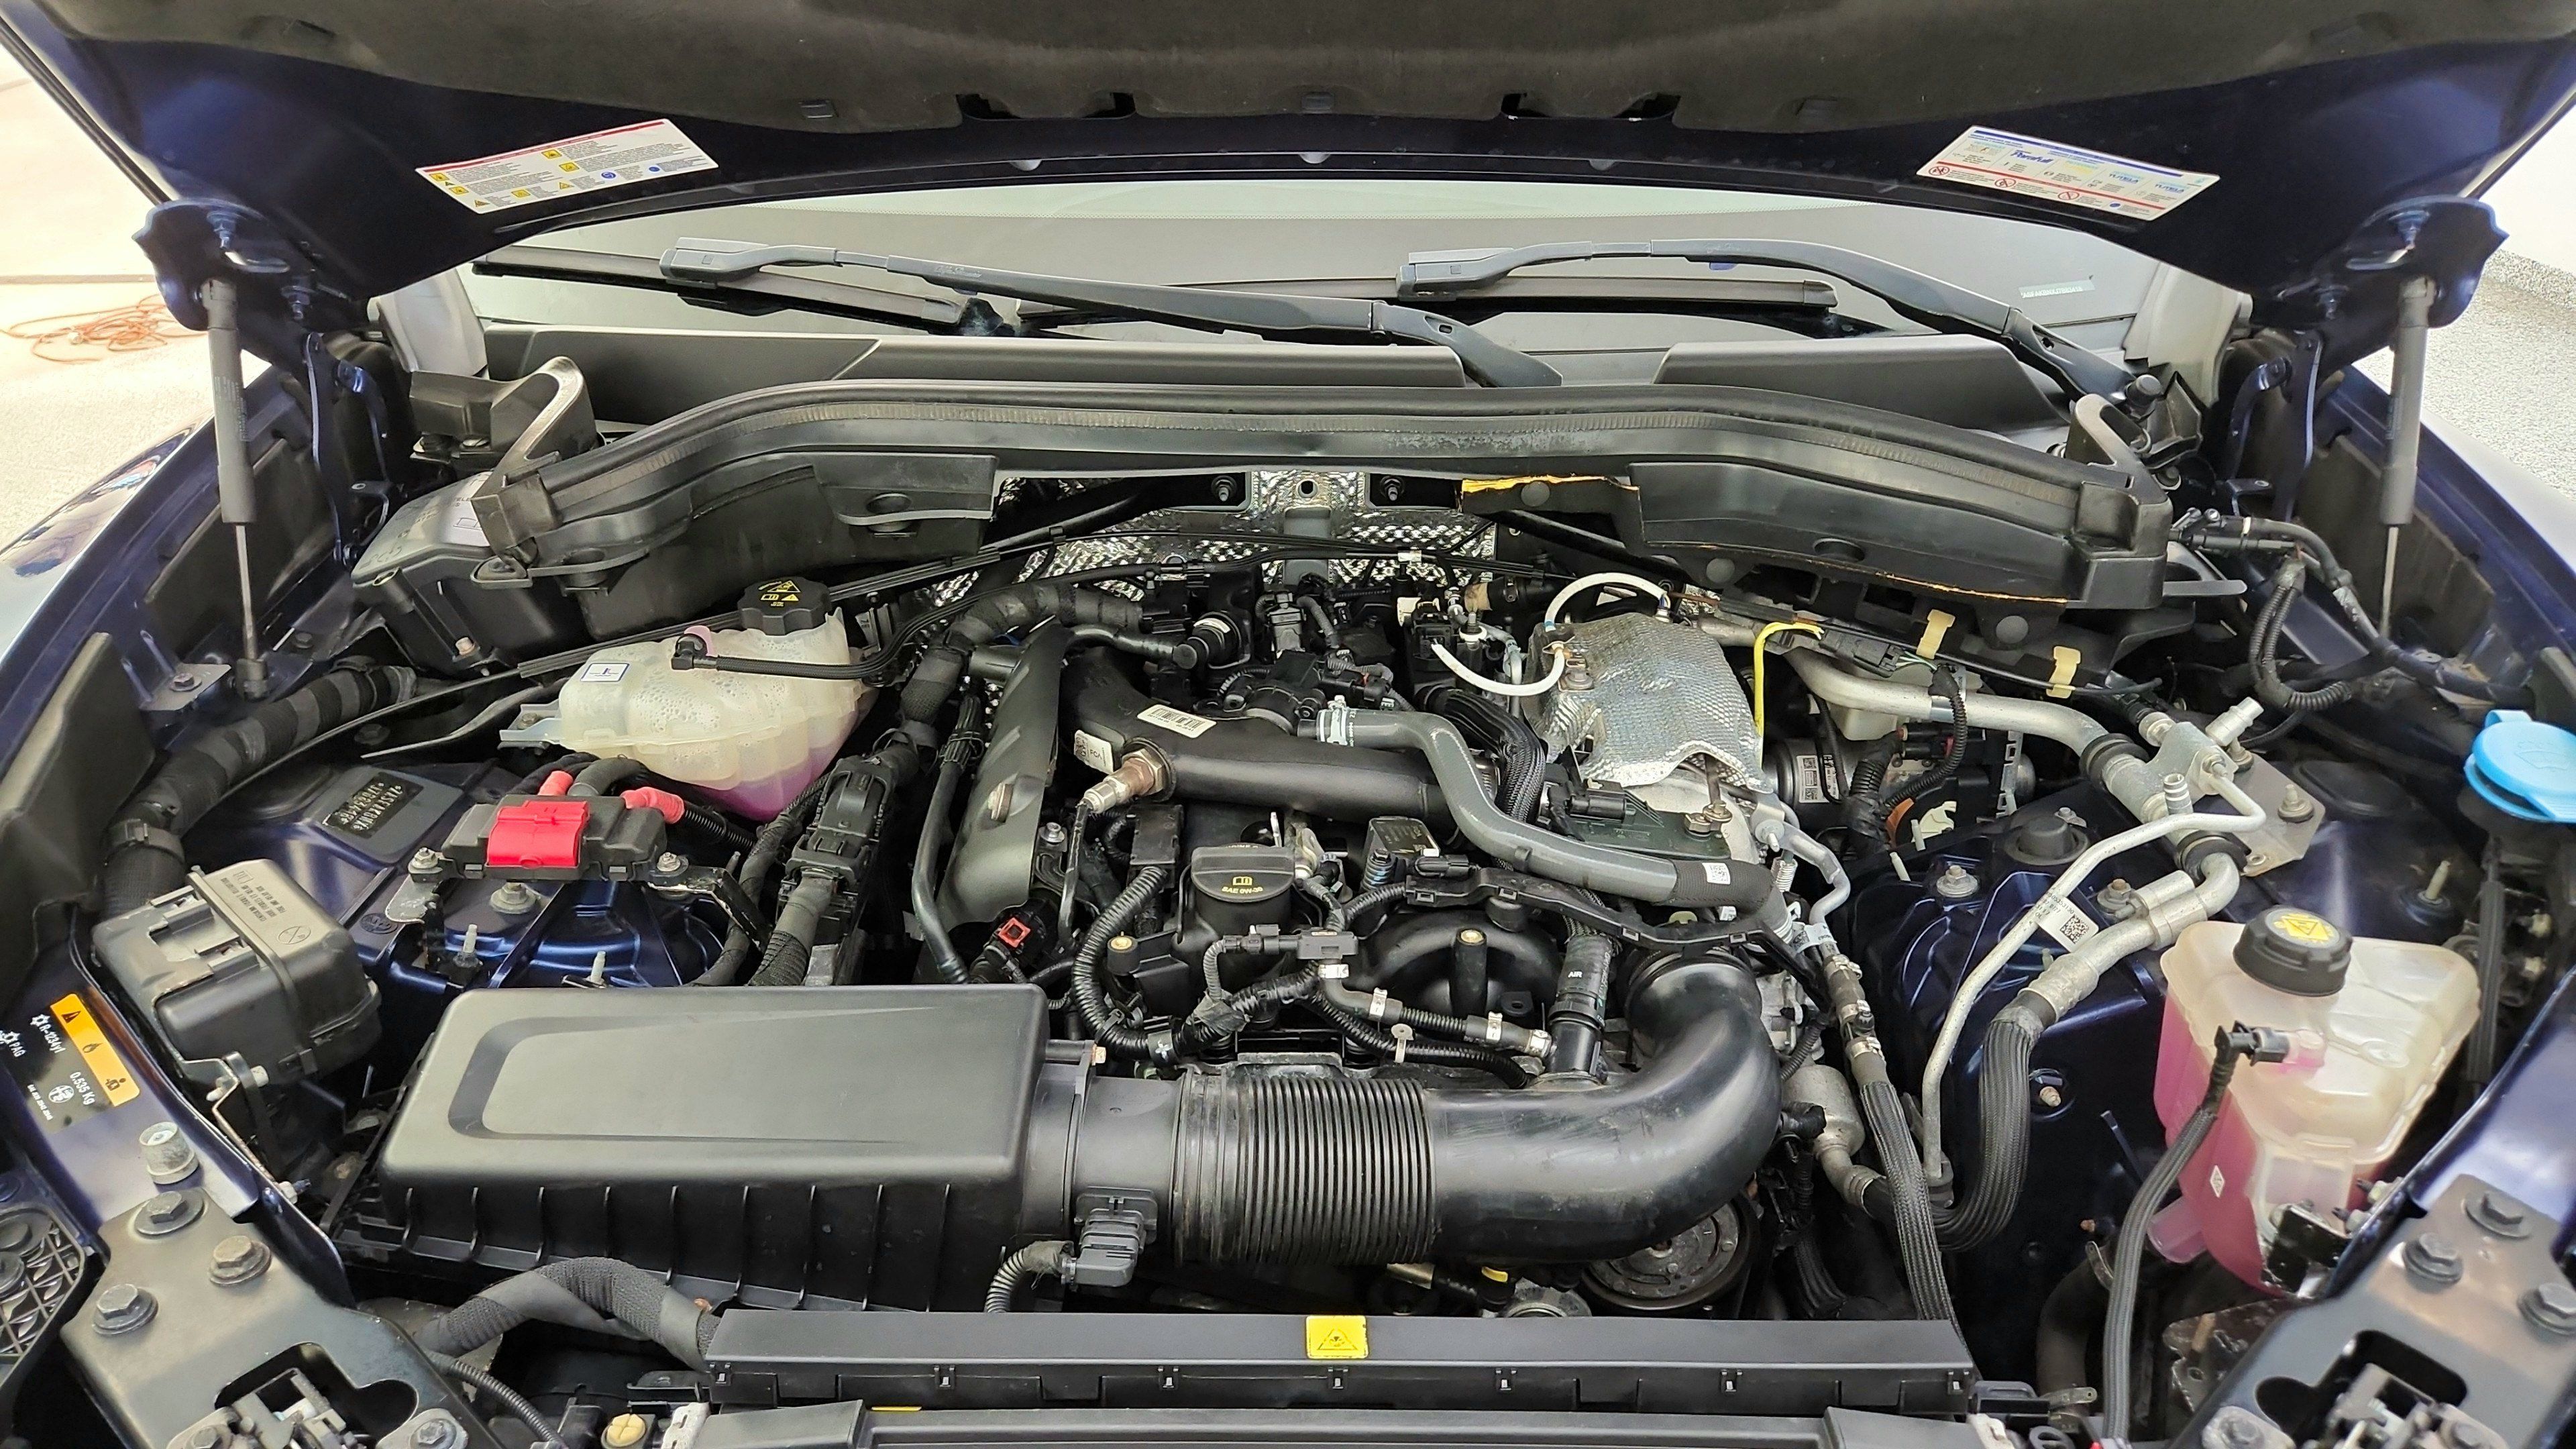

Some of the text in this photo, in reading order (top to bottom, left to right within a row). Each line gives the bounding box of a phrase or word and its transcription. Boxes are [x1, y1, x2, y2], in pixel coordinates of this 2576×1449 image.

[9, 1041, 26, 1058] PAG
[69, 1071, 96, 1106] 0.535 Kg
